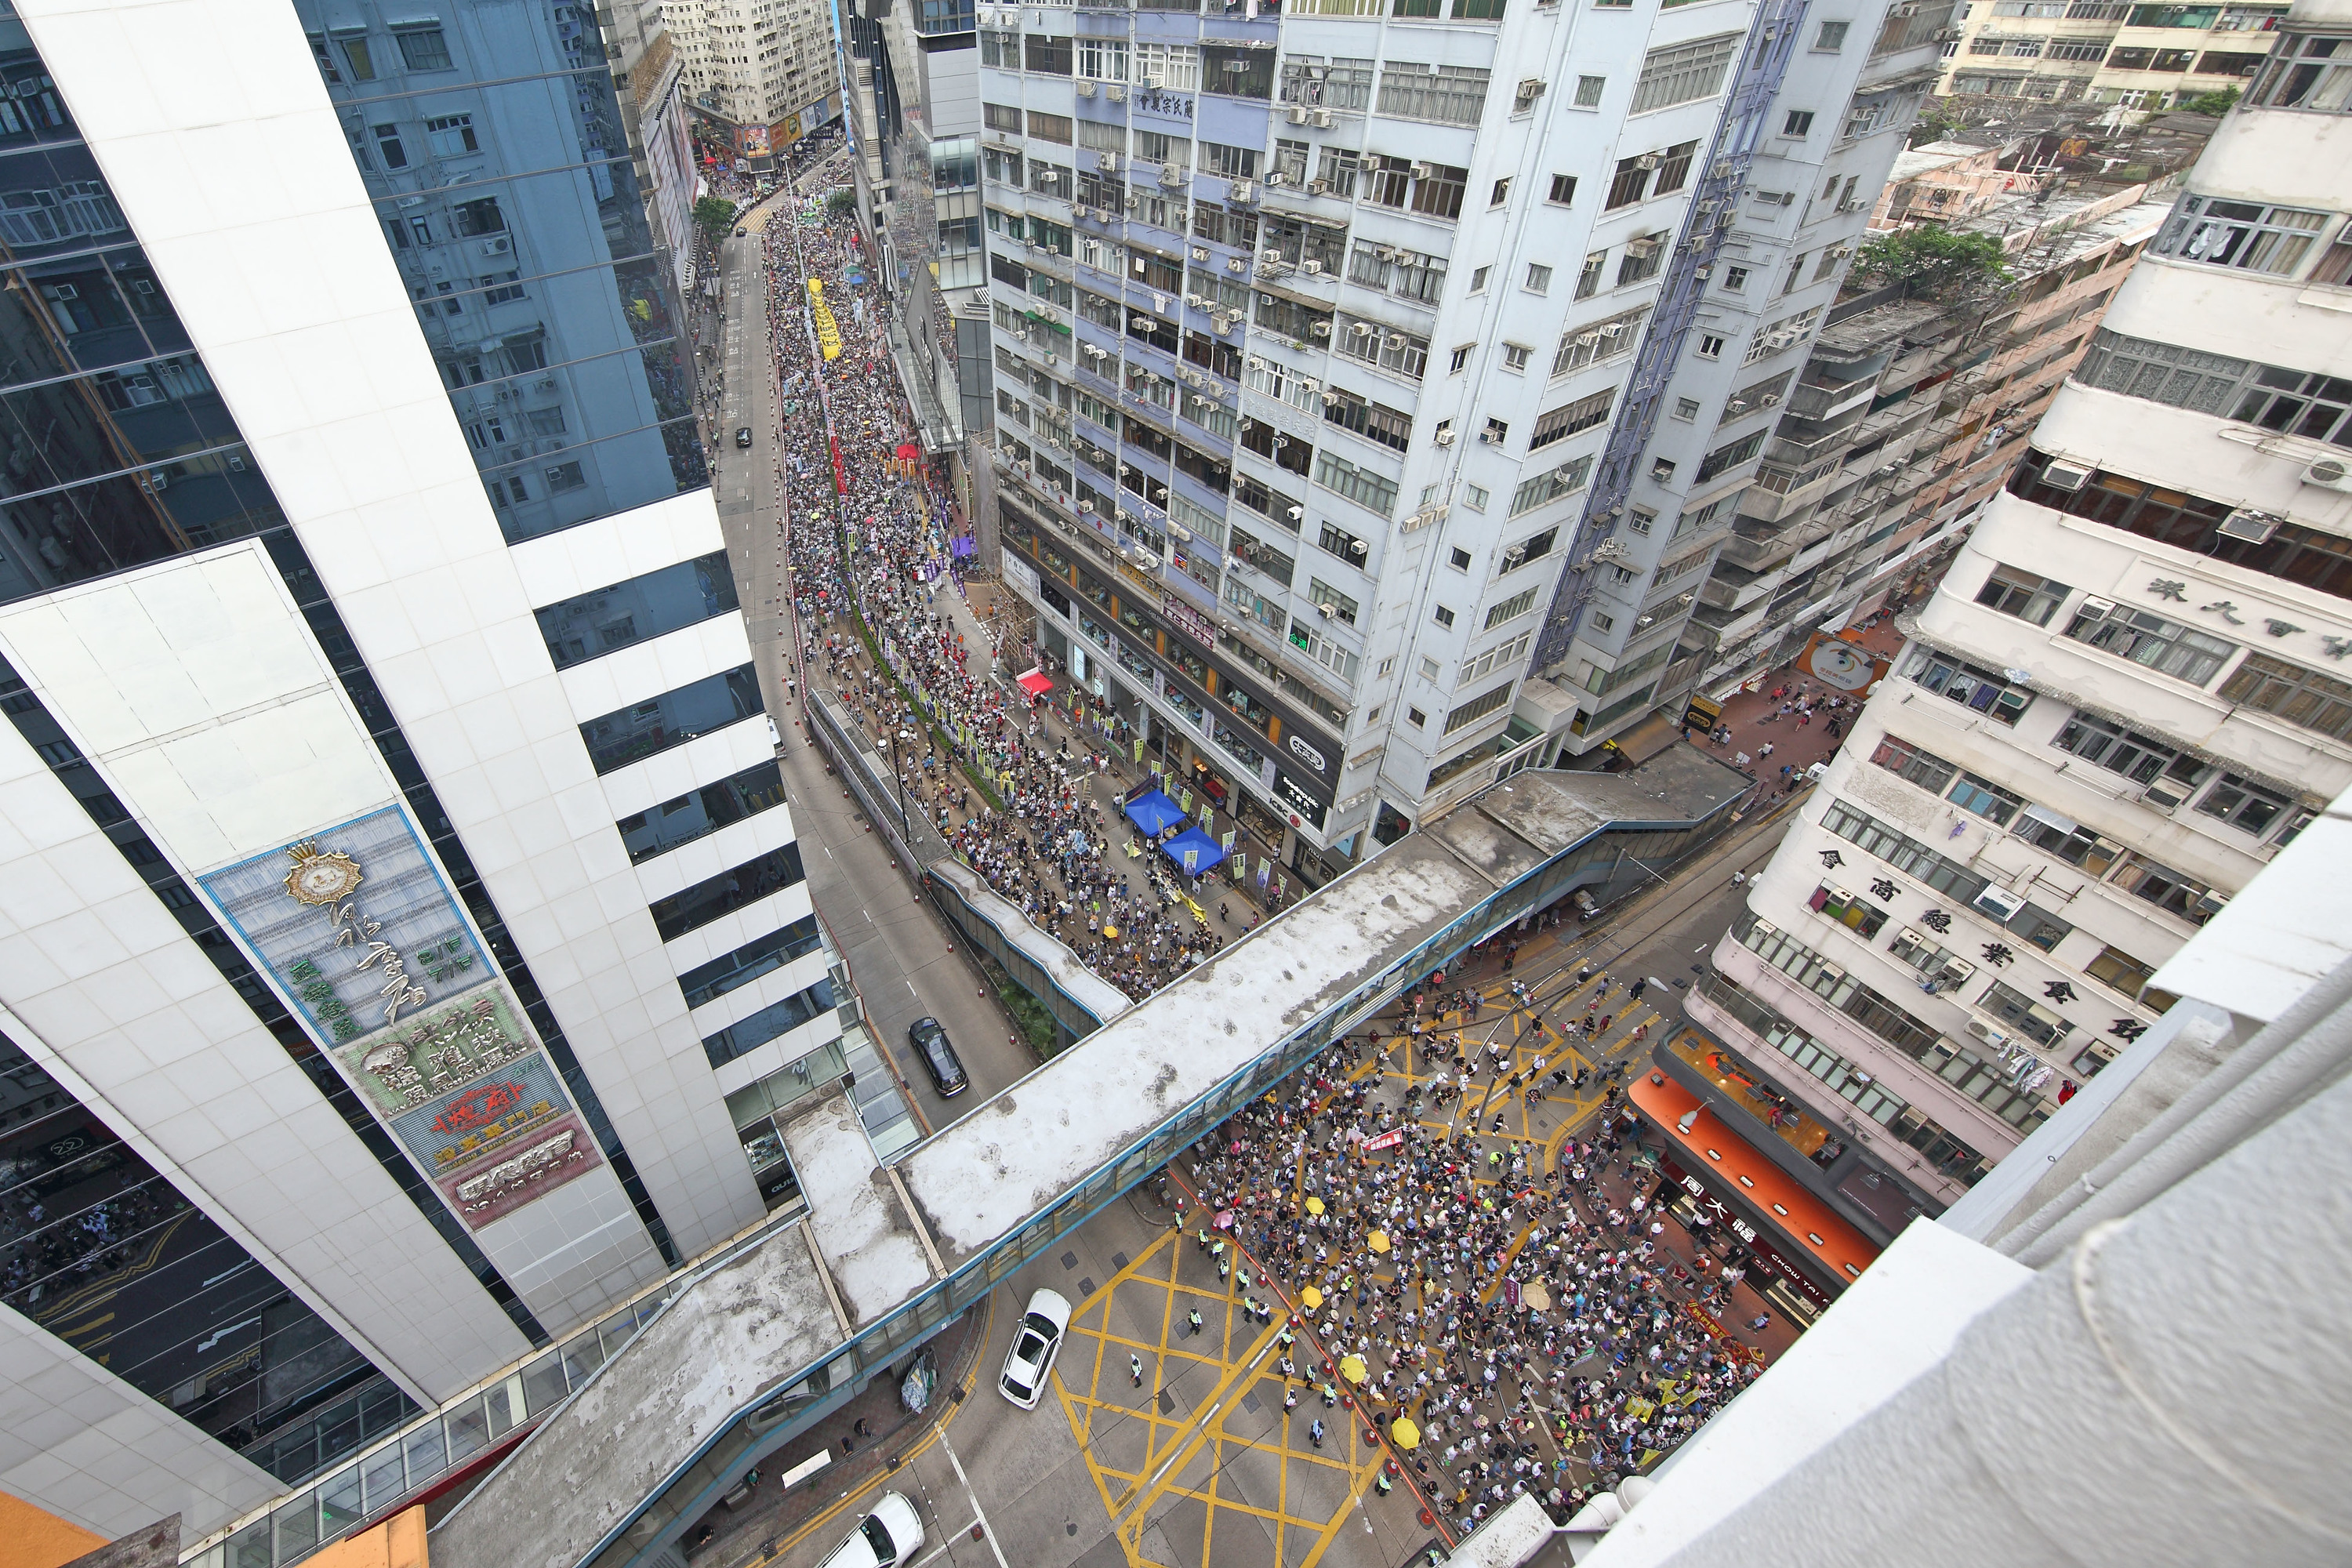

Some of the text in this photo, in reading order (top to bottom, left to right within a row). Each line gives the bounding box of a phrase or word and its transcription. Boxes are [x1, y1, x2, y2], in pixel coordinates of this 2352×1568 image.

[1269, 797, 1289, 818] ICBC
[416, 936, 462, 967] 8/F
[427, 954, 474, 985] 7/F
[437, 1151, 478, 1174] Wedding
[462, 1133, 571, 1201] 現代教育
[464, 1190, 506, 1214] No.1
[1680, 1174, 1757, 1243] 周大福
[1770, 1254, 1801, 1279] CHOW
[1802, 1279, 1820, 1296] TAI
